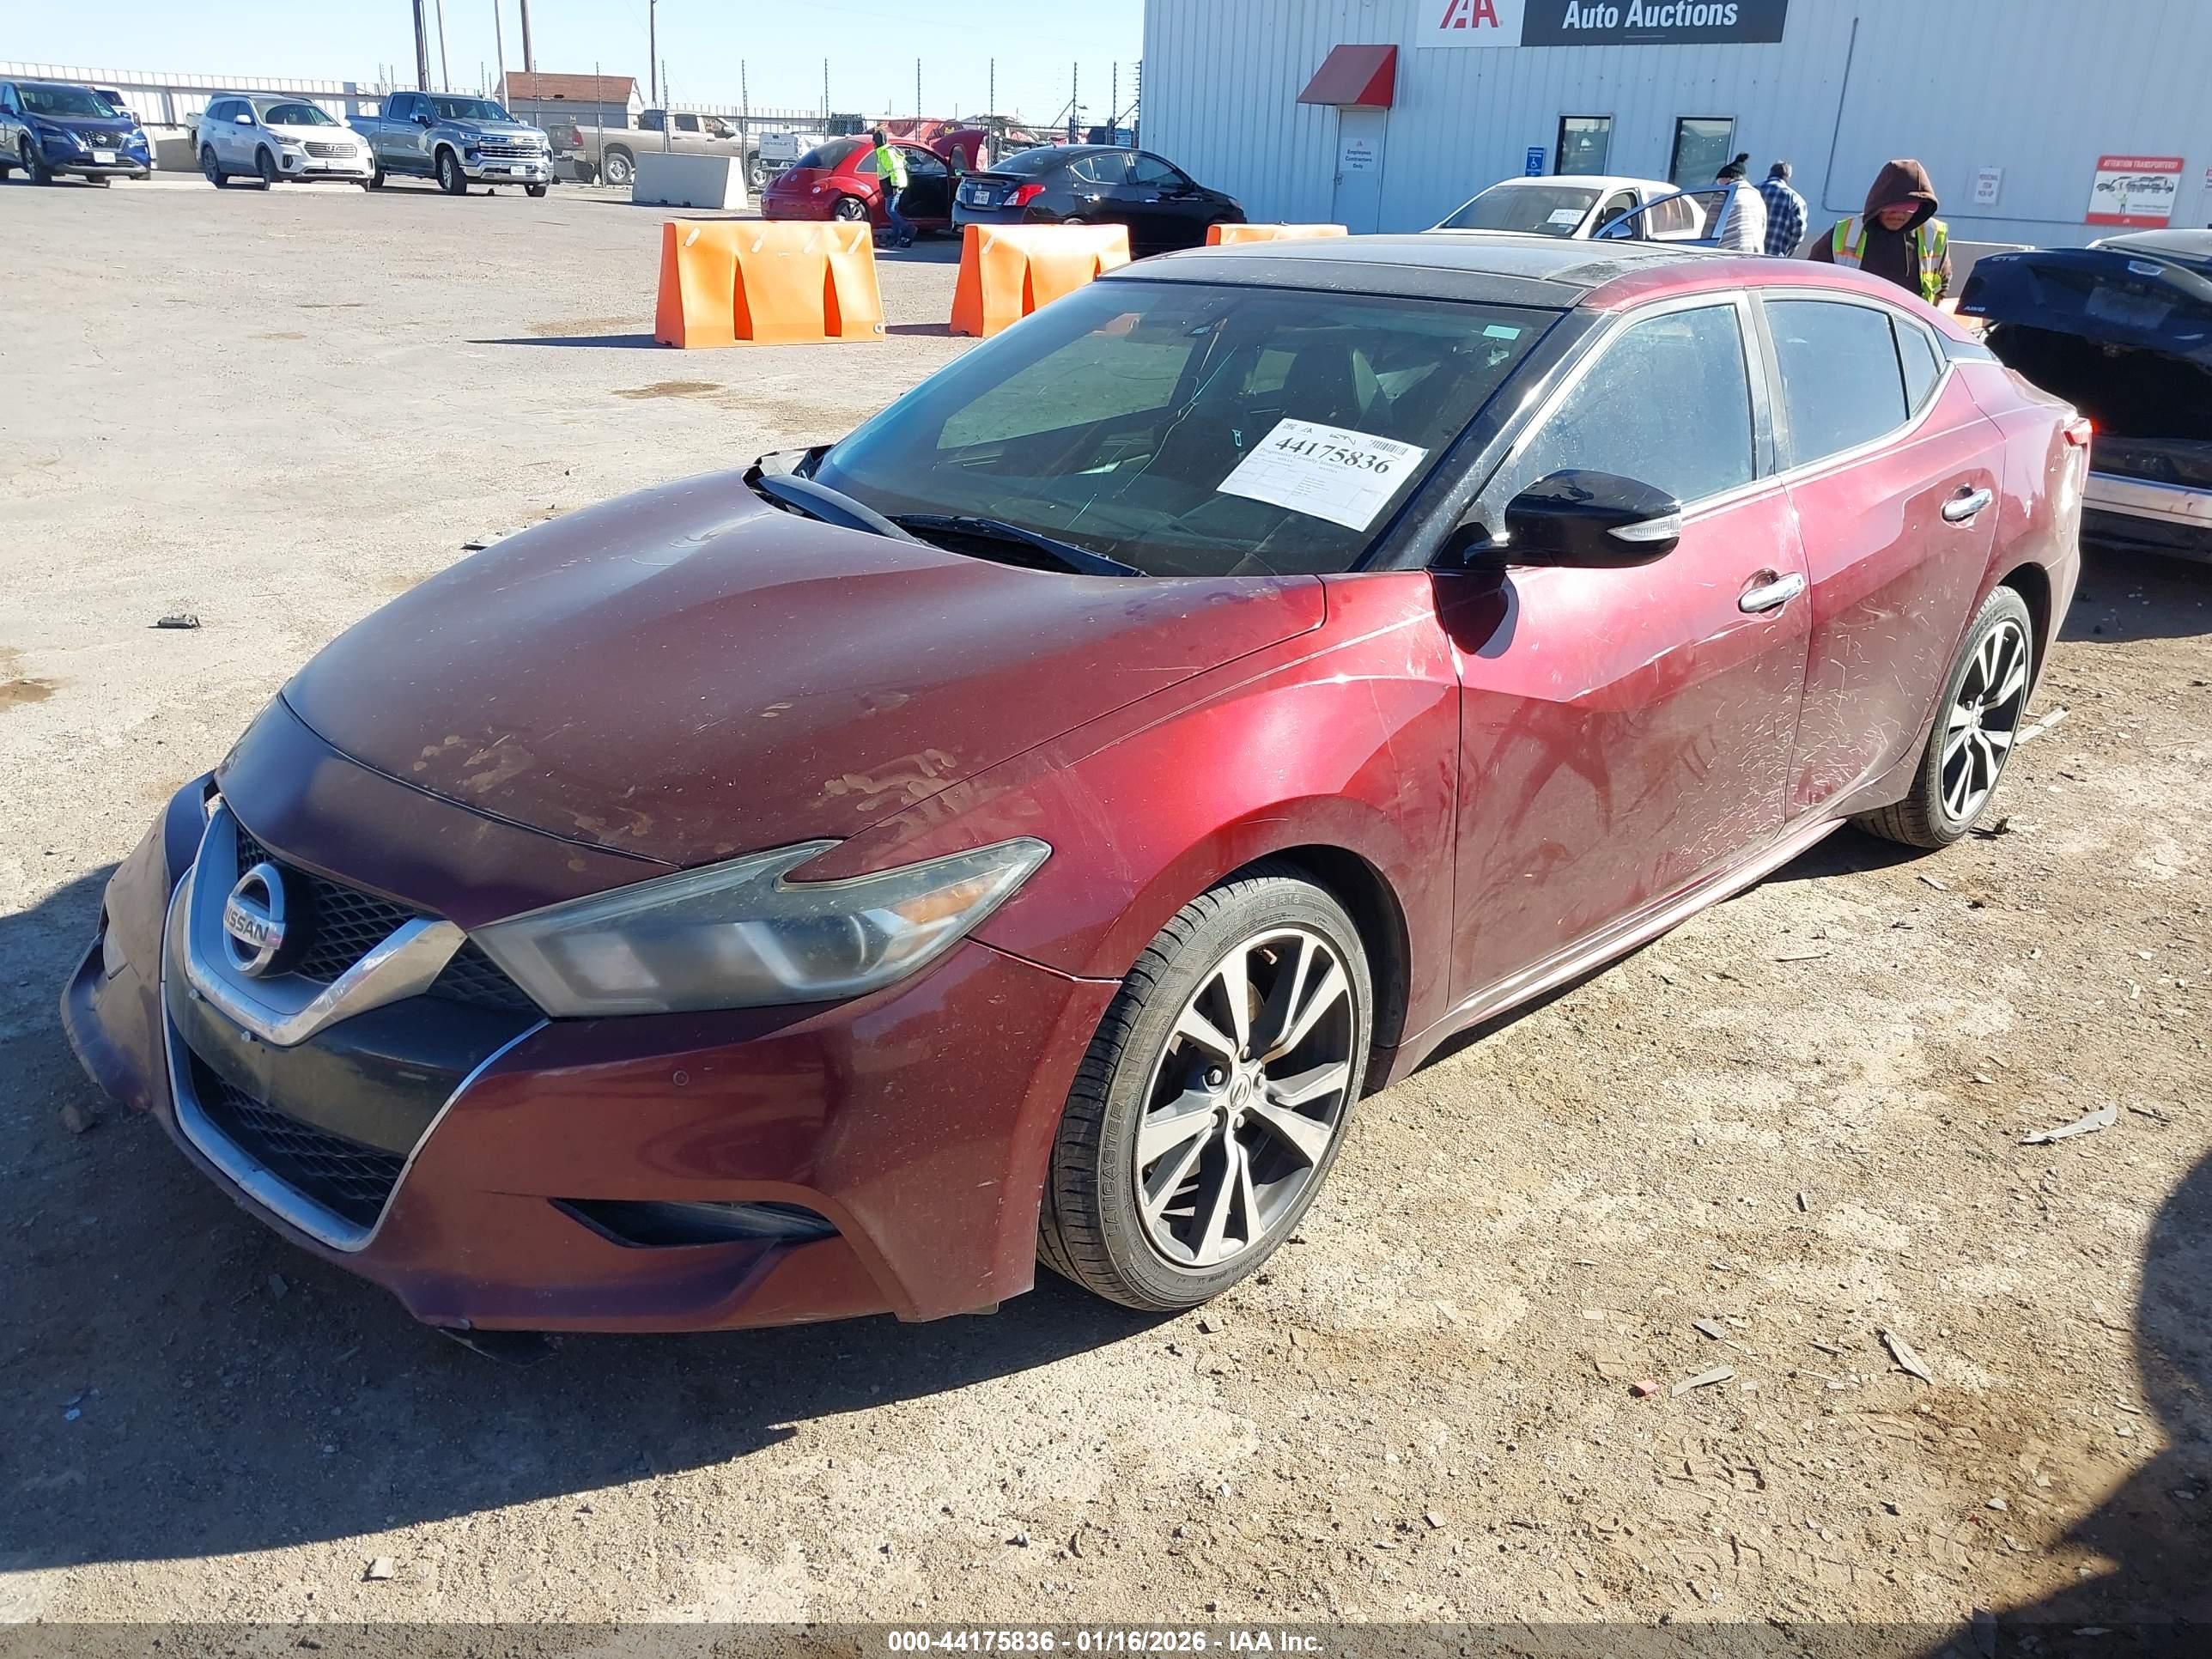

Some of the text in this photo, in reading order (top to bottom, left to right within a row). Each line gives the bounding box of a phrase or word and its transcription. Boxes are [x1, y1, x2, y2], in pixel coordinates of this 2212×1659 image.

[1562, 0, 1738, 29] Auto Auctions
[2103, 159, 2132, 168] ATTENTION
[1275, 437, 1396, 474] 44175836
